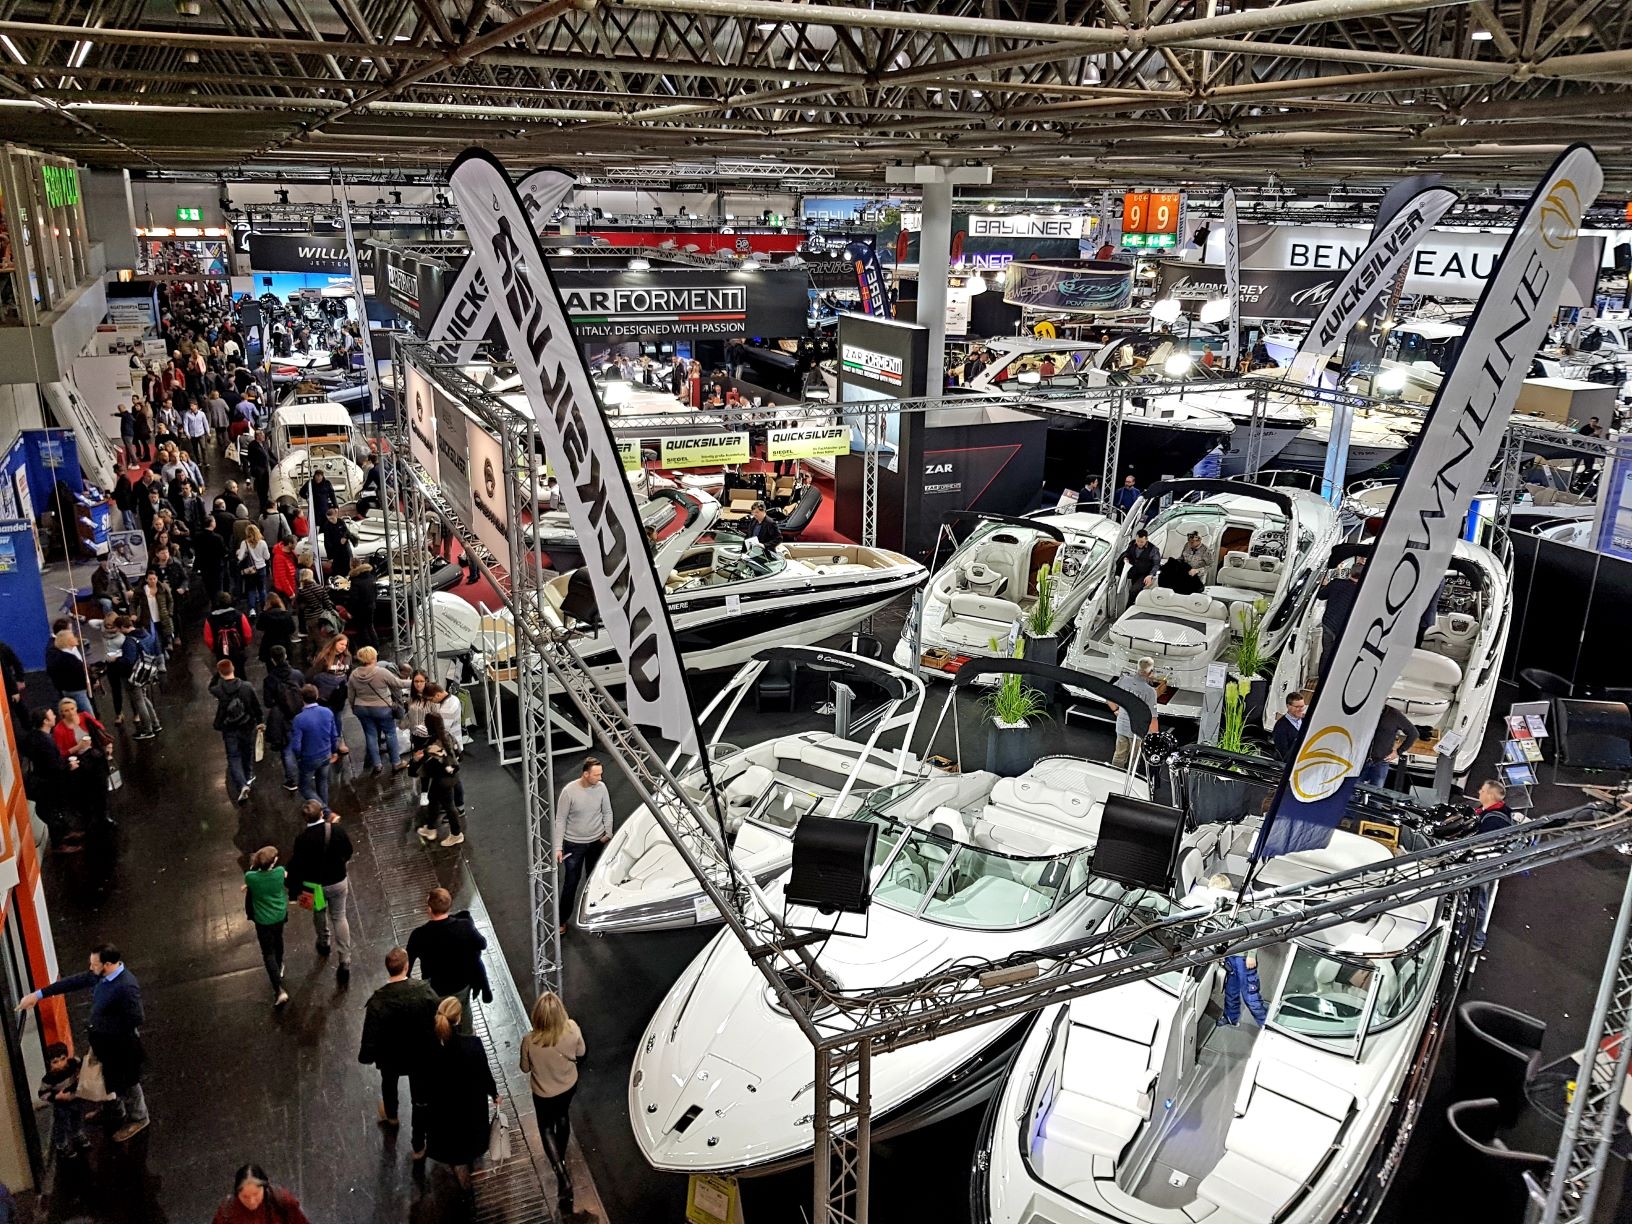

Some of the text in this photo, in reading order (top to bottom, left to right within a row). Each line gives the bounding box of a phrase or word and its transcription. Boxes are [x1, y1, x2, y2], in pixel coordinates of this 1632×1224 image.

[1130, 205, 1140, 229] 9
[1157, 205, 1169, 230] 9
[975, 220, 1072, 236] BAYLINER
[961, 255, 1013, 269] LINER
[1291, 243, 1500, 280] BENEAU
[1320, 208, 1425, 348] QUICKSILVER
[1193, 282, 1269, 295] MONTREY
[582, 326, 613, 336] ITALY.
[615, 325, 670, 335] DESIGNED
[672, 324, 699, 334] WITH
[701, 322, 745, 332] PASSION
[666, 436, 742, 450] QUICKSILVER
[772, 429, 843, 443] QUICKSILVER
[925, 463, 953, 475] ZAR
[1340, 248, 1550, 717] CROWNLINE
